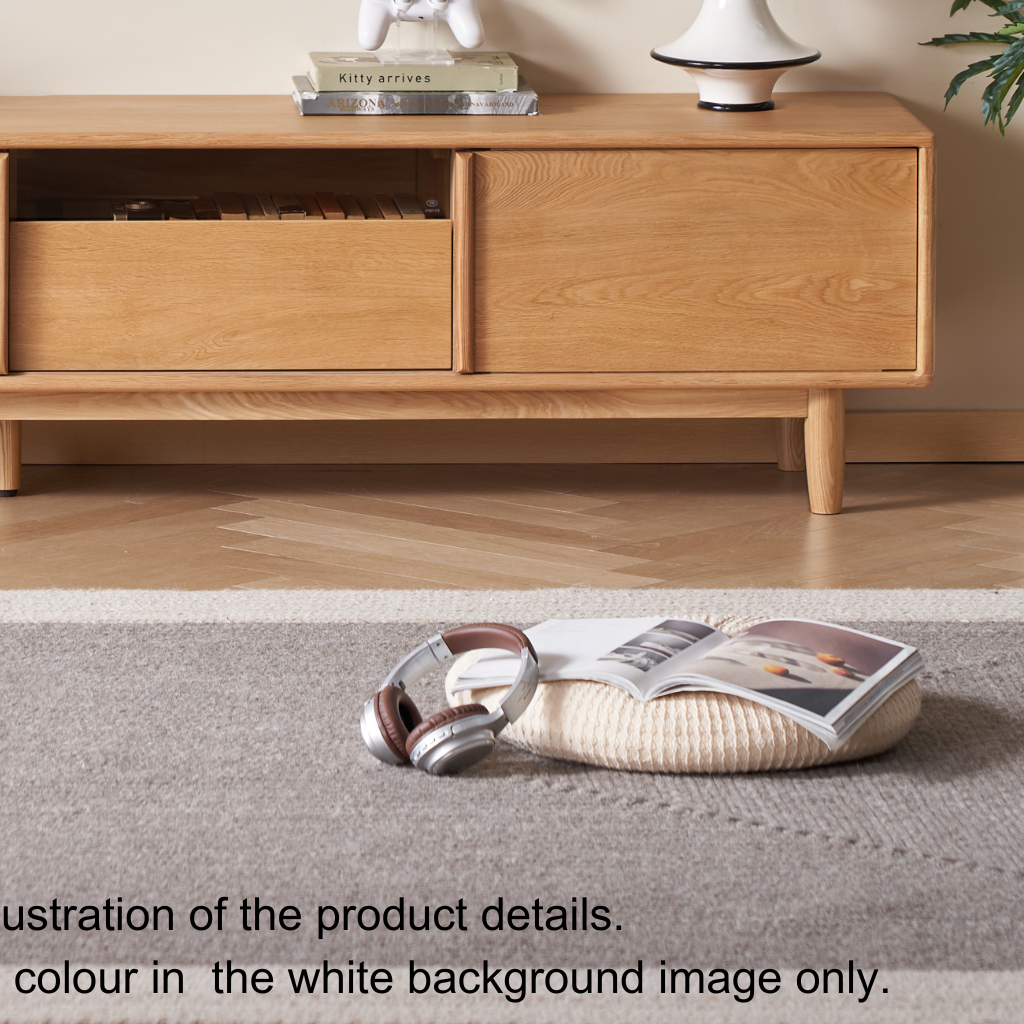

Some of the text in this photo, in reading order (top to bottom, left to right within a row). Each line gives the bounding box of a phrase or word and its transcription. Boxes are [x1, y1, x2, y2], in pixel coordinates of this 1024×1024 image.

[338, 73, 431, 85] Kitty arrives
[328, 98, 386, 108] ARIZONA
